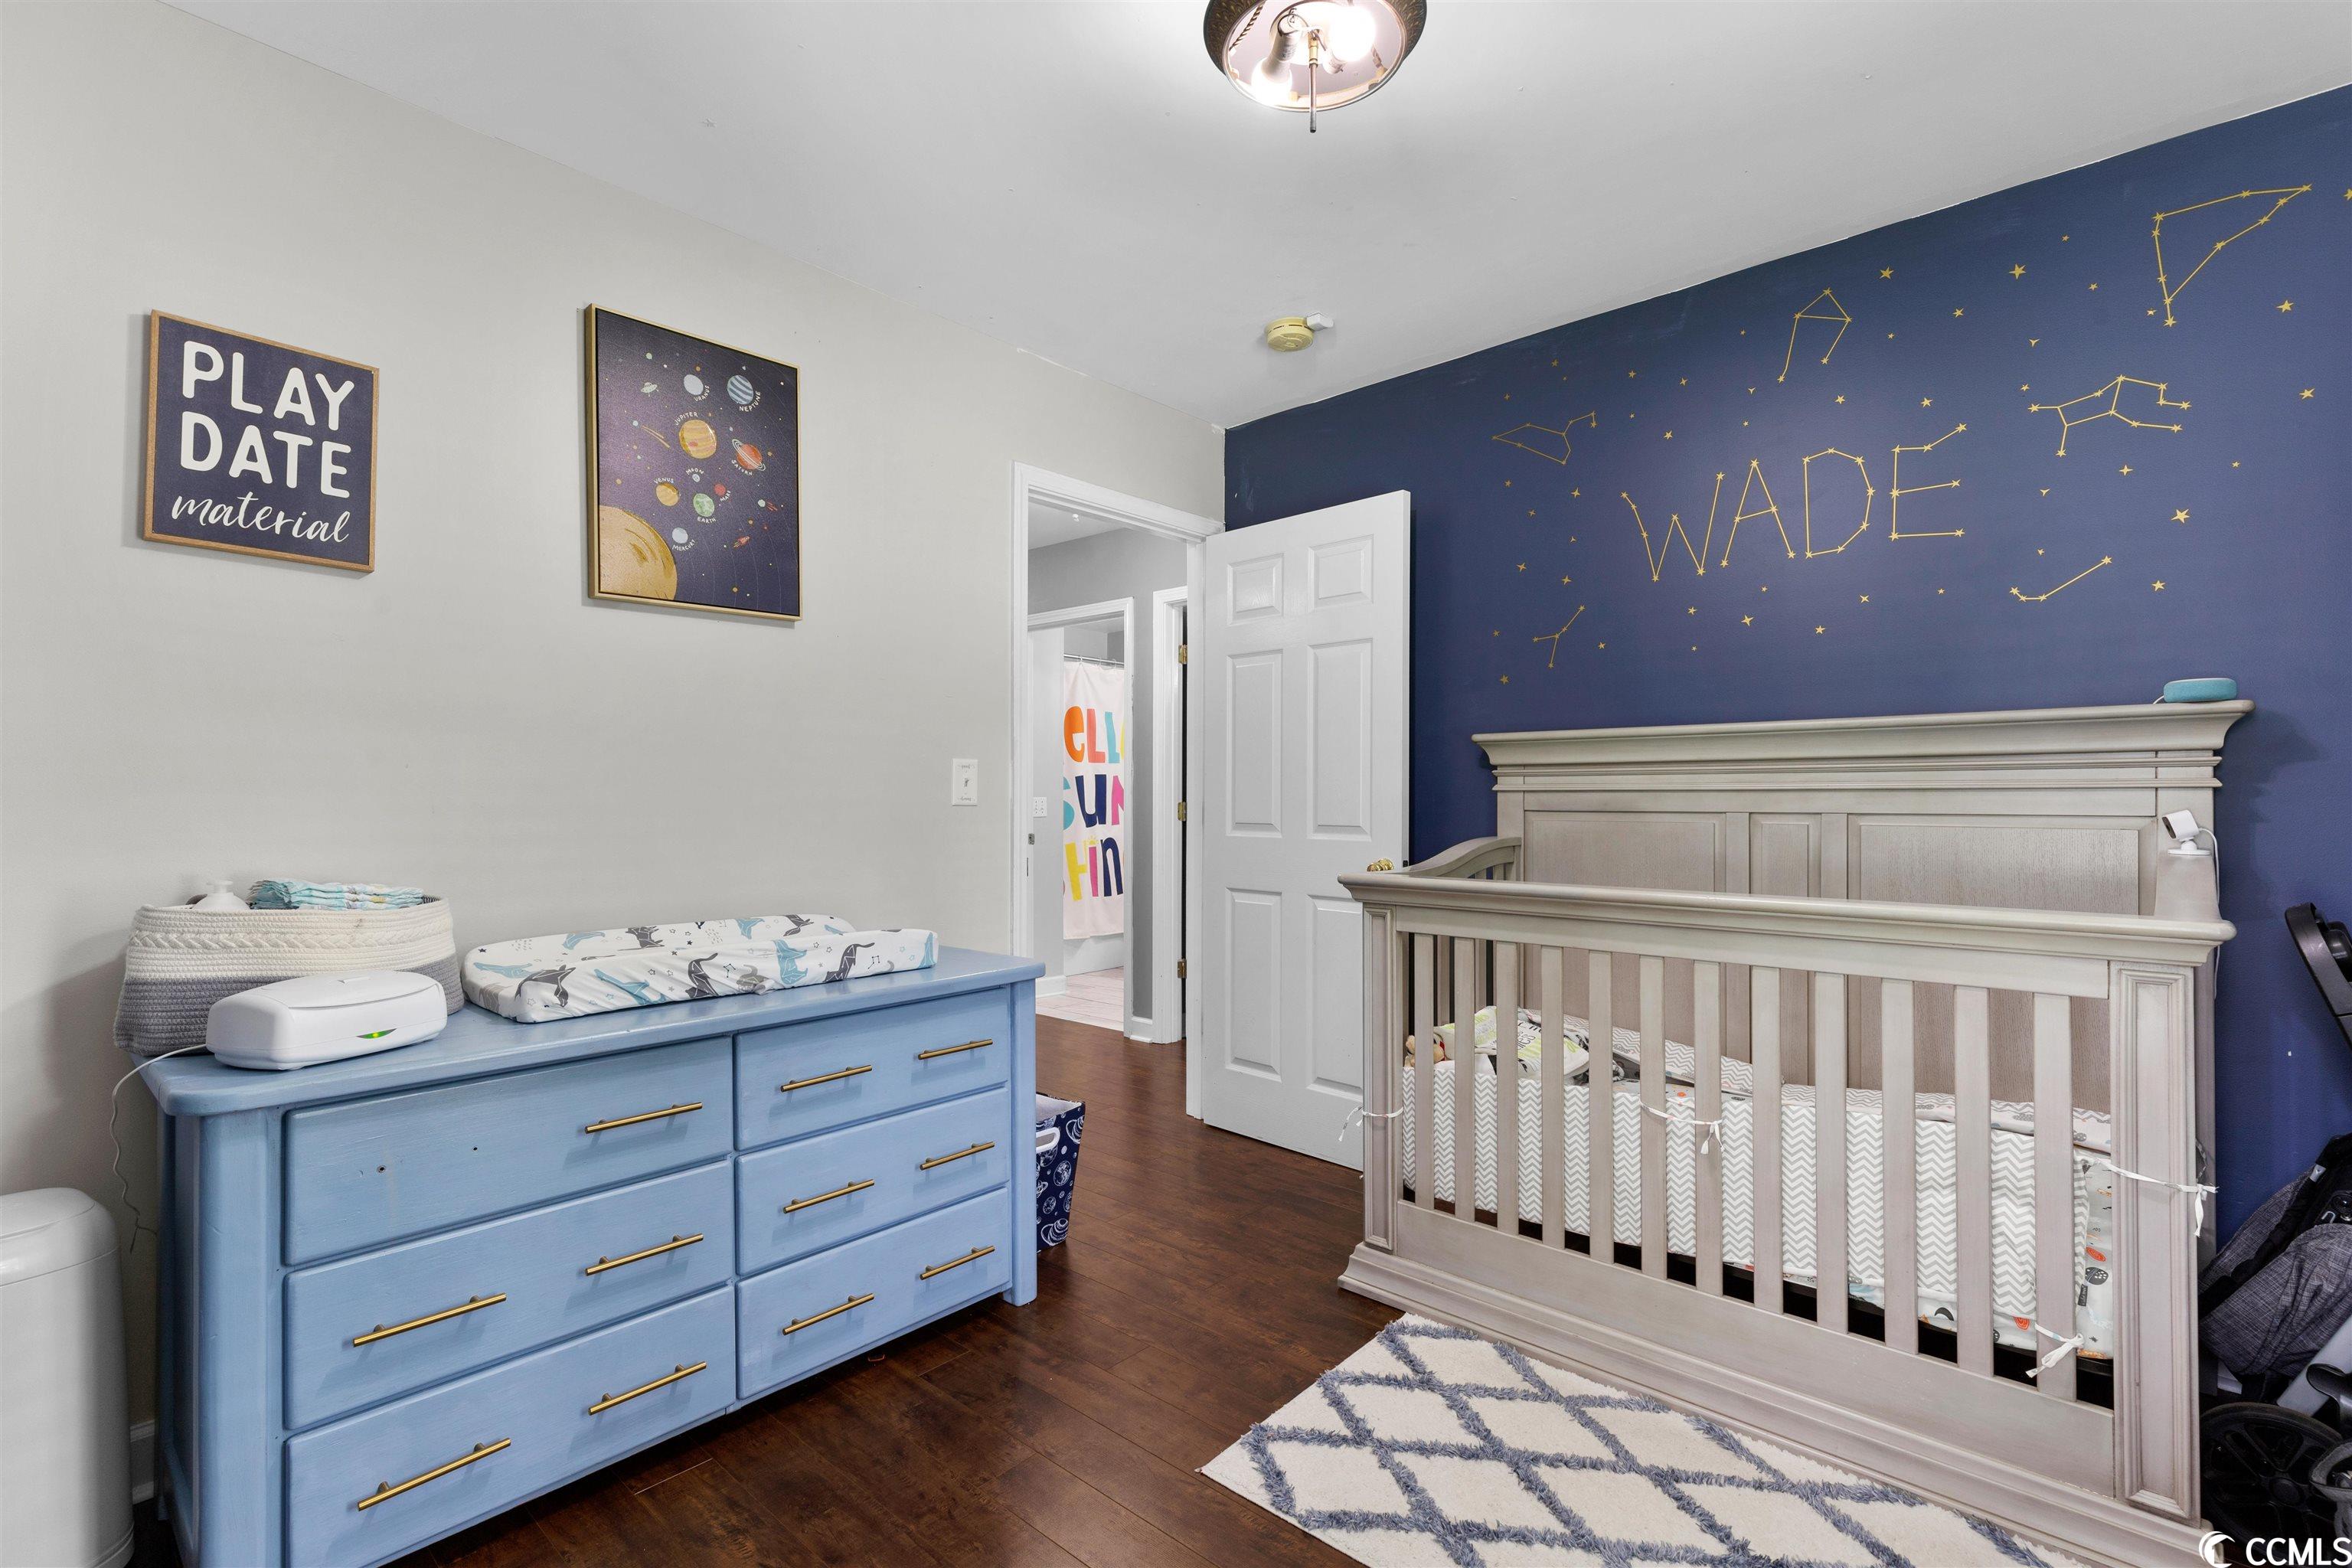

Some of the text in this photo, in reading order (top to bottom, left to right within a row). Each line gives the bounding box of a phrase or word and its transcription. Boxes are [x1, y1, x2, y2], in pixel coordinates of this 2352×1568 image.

[182, 341, 354, 431] PLAY
[694, 385, 710, 402] URANUS
[739, 390, 761, 412] NEPTUNE
[674, 411, 698, 426] JUPITER
[181, 411, 351, 498] DATE
[731, 459, 753, 475] SATURN
[172, 491, 351, 543] material
[1621, 422, 1967, 582] WADE
[671, 539, 696, 551] MERCURY
[1063, 706, 1125, 763] eLL
